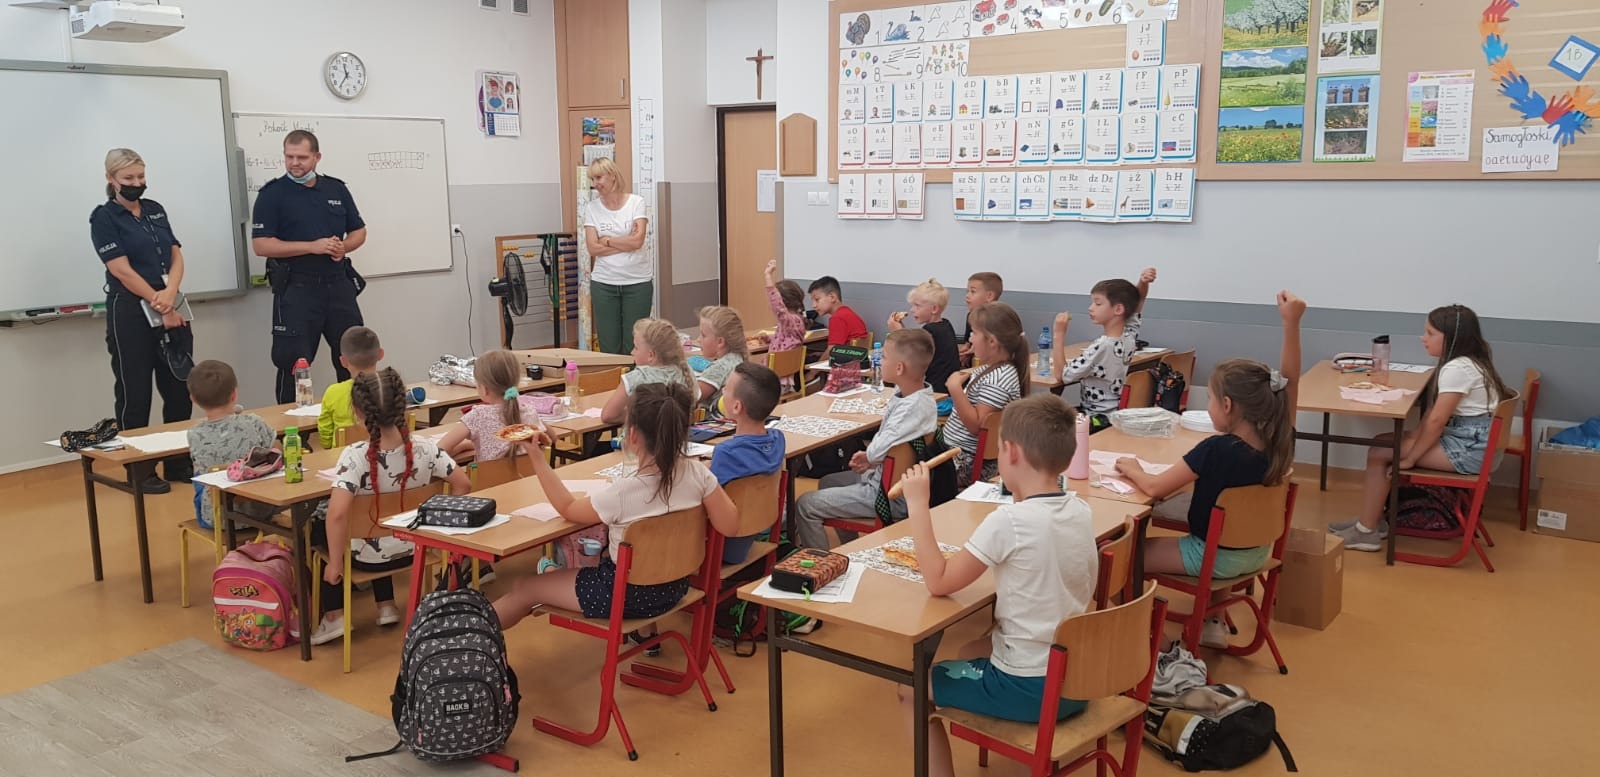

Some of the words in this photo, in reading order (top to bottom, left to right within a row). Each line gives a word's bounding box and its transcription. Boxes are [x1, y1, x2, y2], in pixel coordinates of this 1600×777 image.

[1060, 12, 1068, 28] 5
[1113, 7, 1122, 24] 6
[962, 22, 970, 37] 3
[1010, 18, 1017, 33] 4
[875, 31, 880, 46] 1
[917, 26, 925, 42] 2
[874, 67, 880, 82] 8
[916, 64, 923, 79] 9
[956, 62, 968, 77] 10
[1485, 127, 1553, 148] Samogłoski
